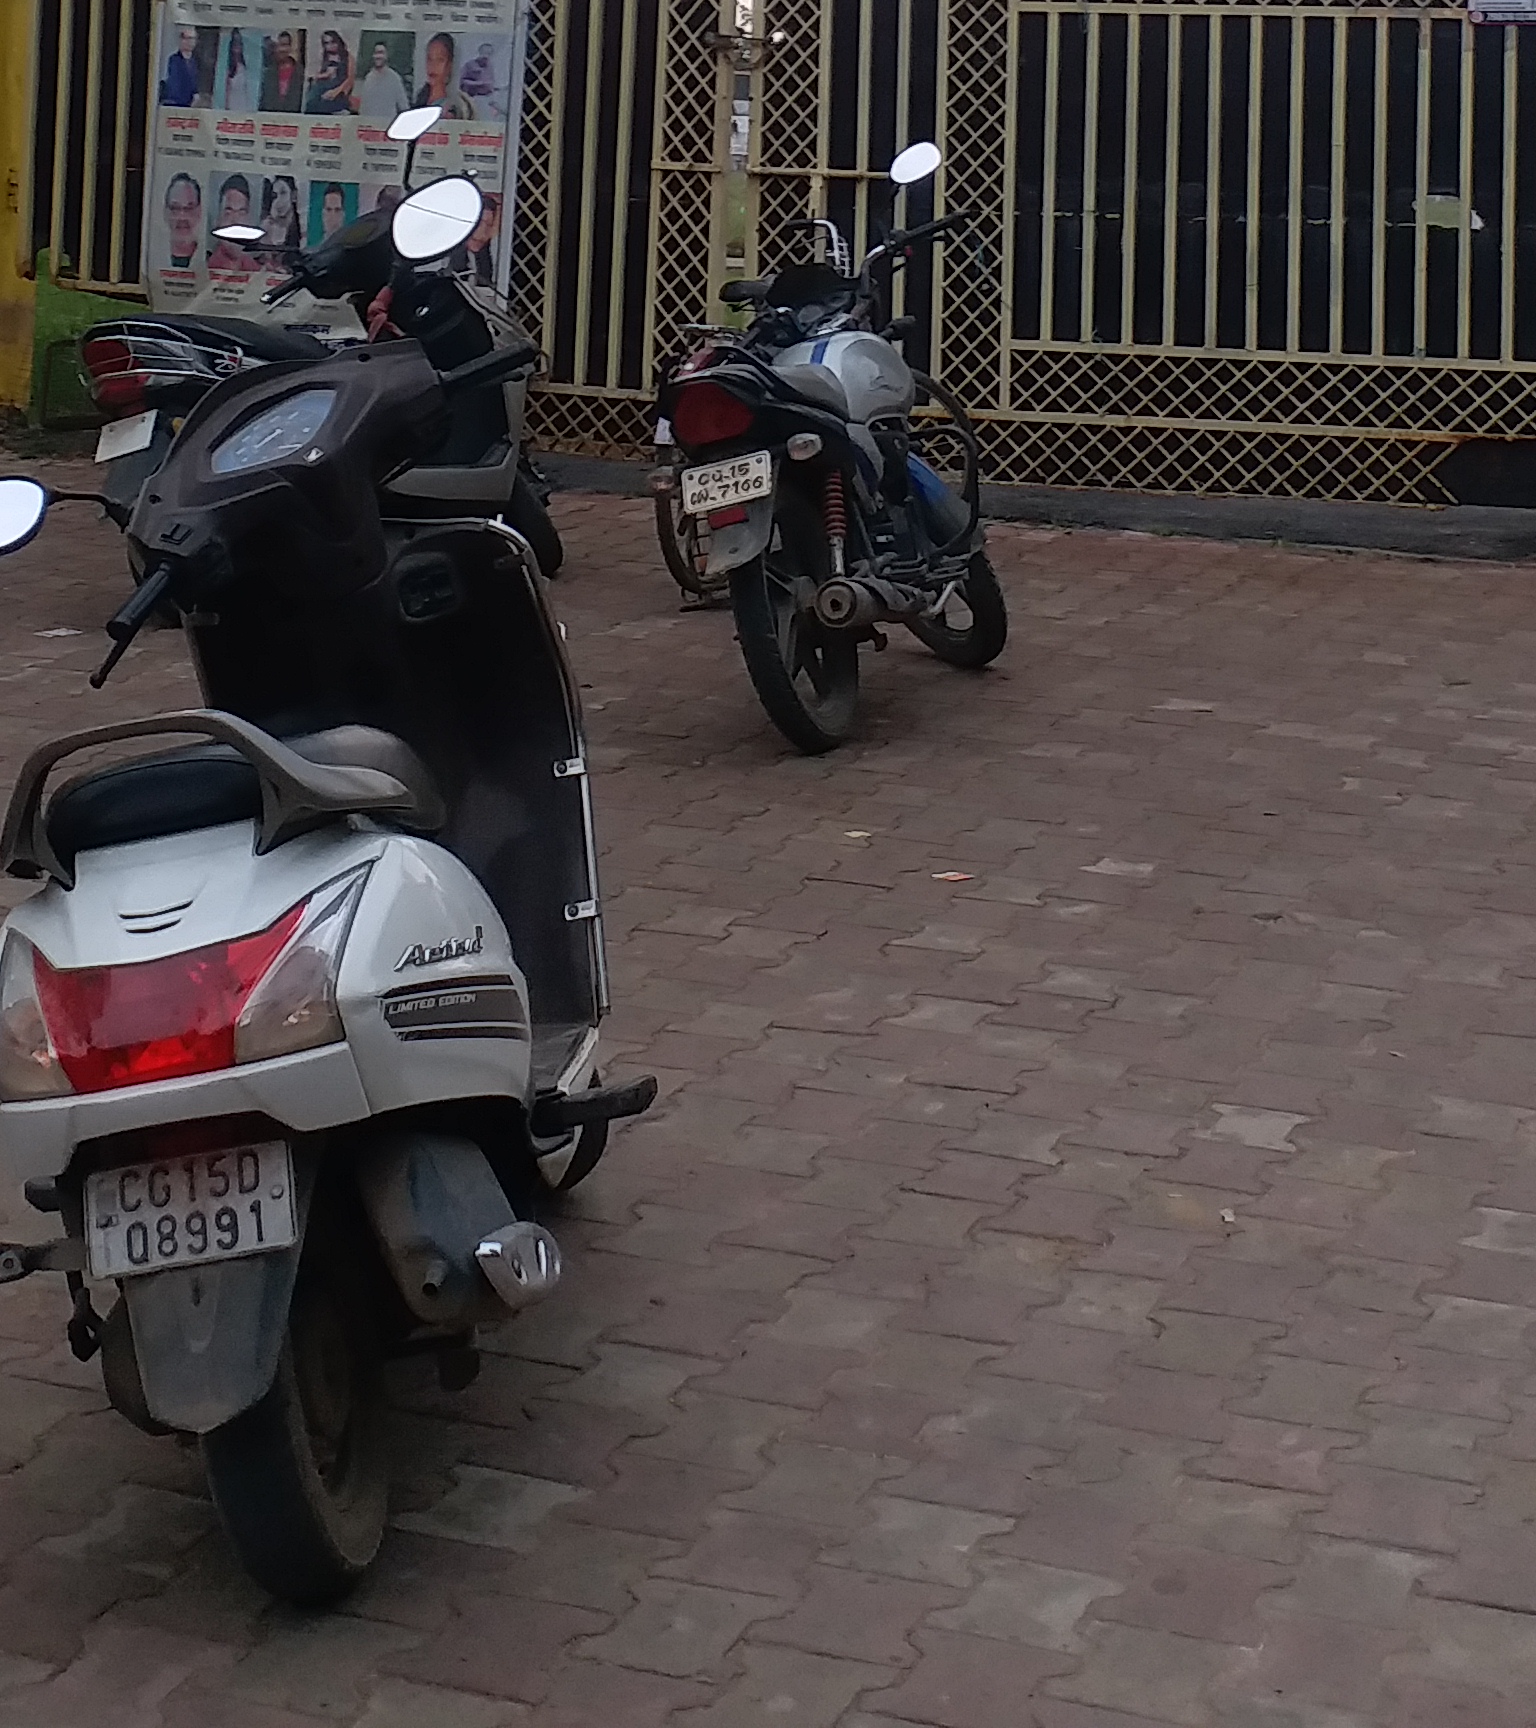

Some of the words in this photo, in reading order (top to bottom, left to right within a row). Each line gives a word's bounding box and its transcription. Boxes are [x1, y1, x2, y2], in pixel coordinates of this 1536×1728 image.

[388, 997, 435, 1015] LIMITED
[438, 992, 477, 1008] EDITION
[119, 1146, 260, 1213] CG15D
